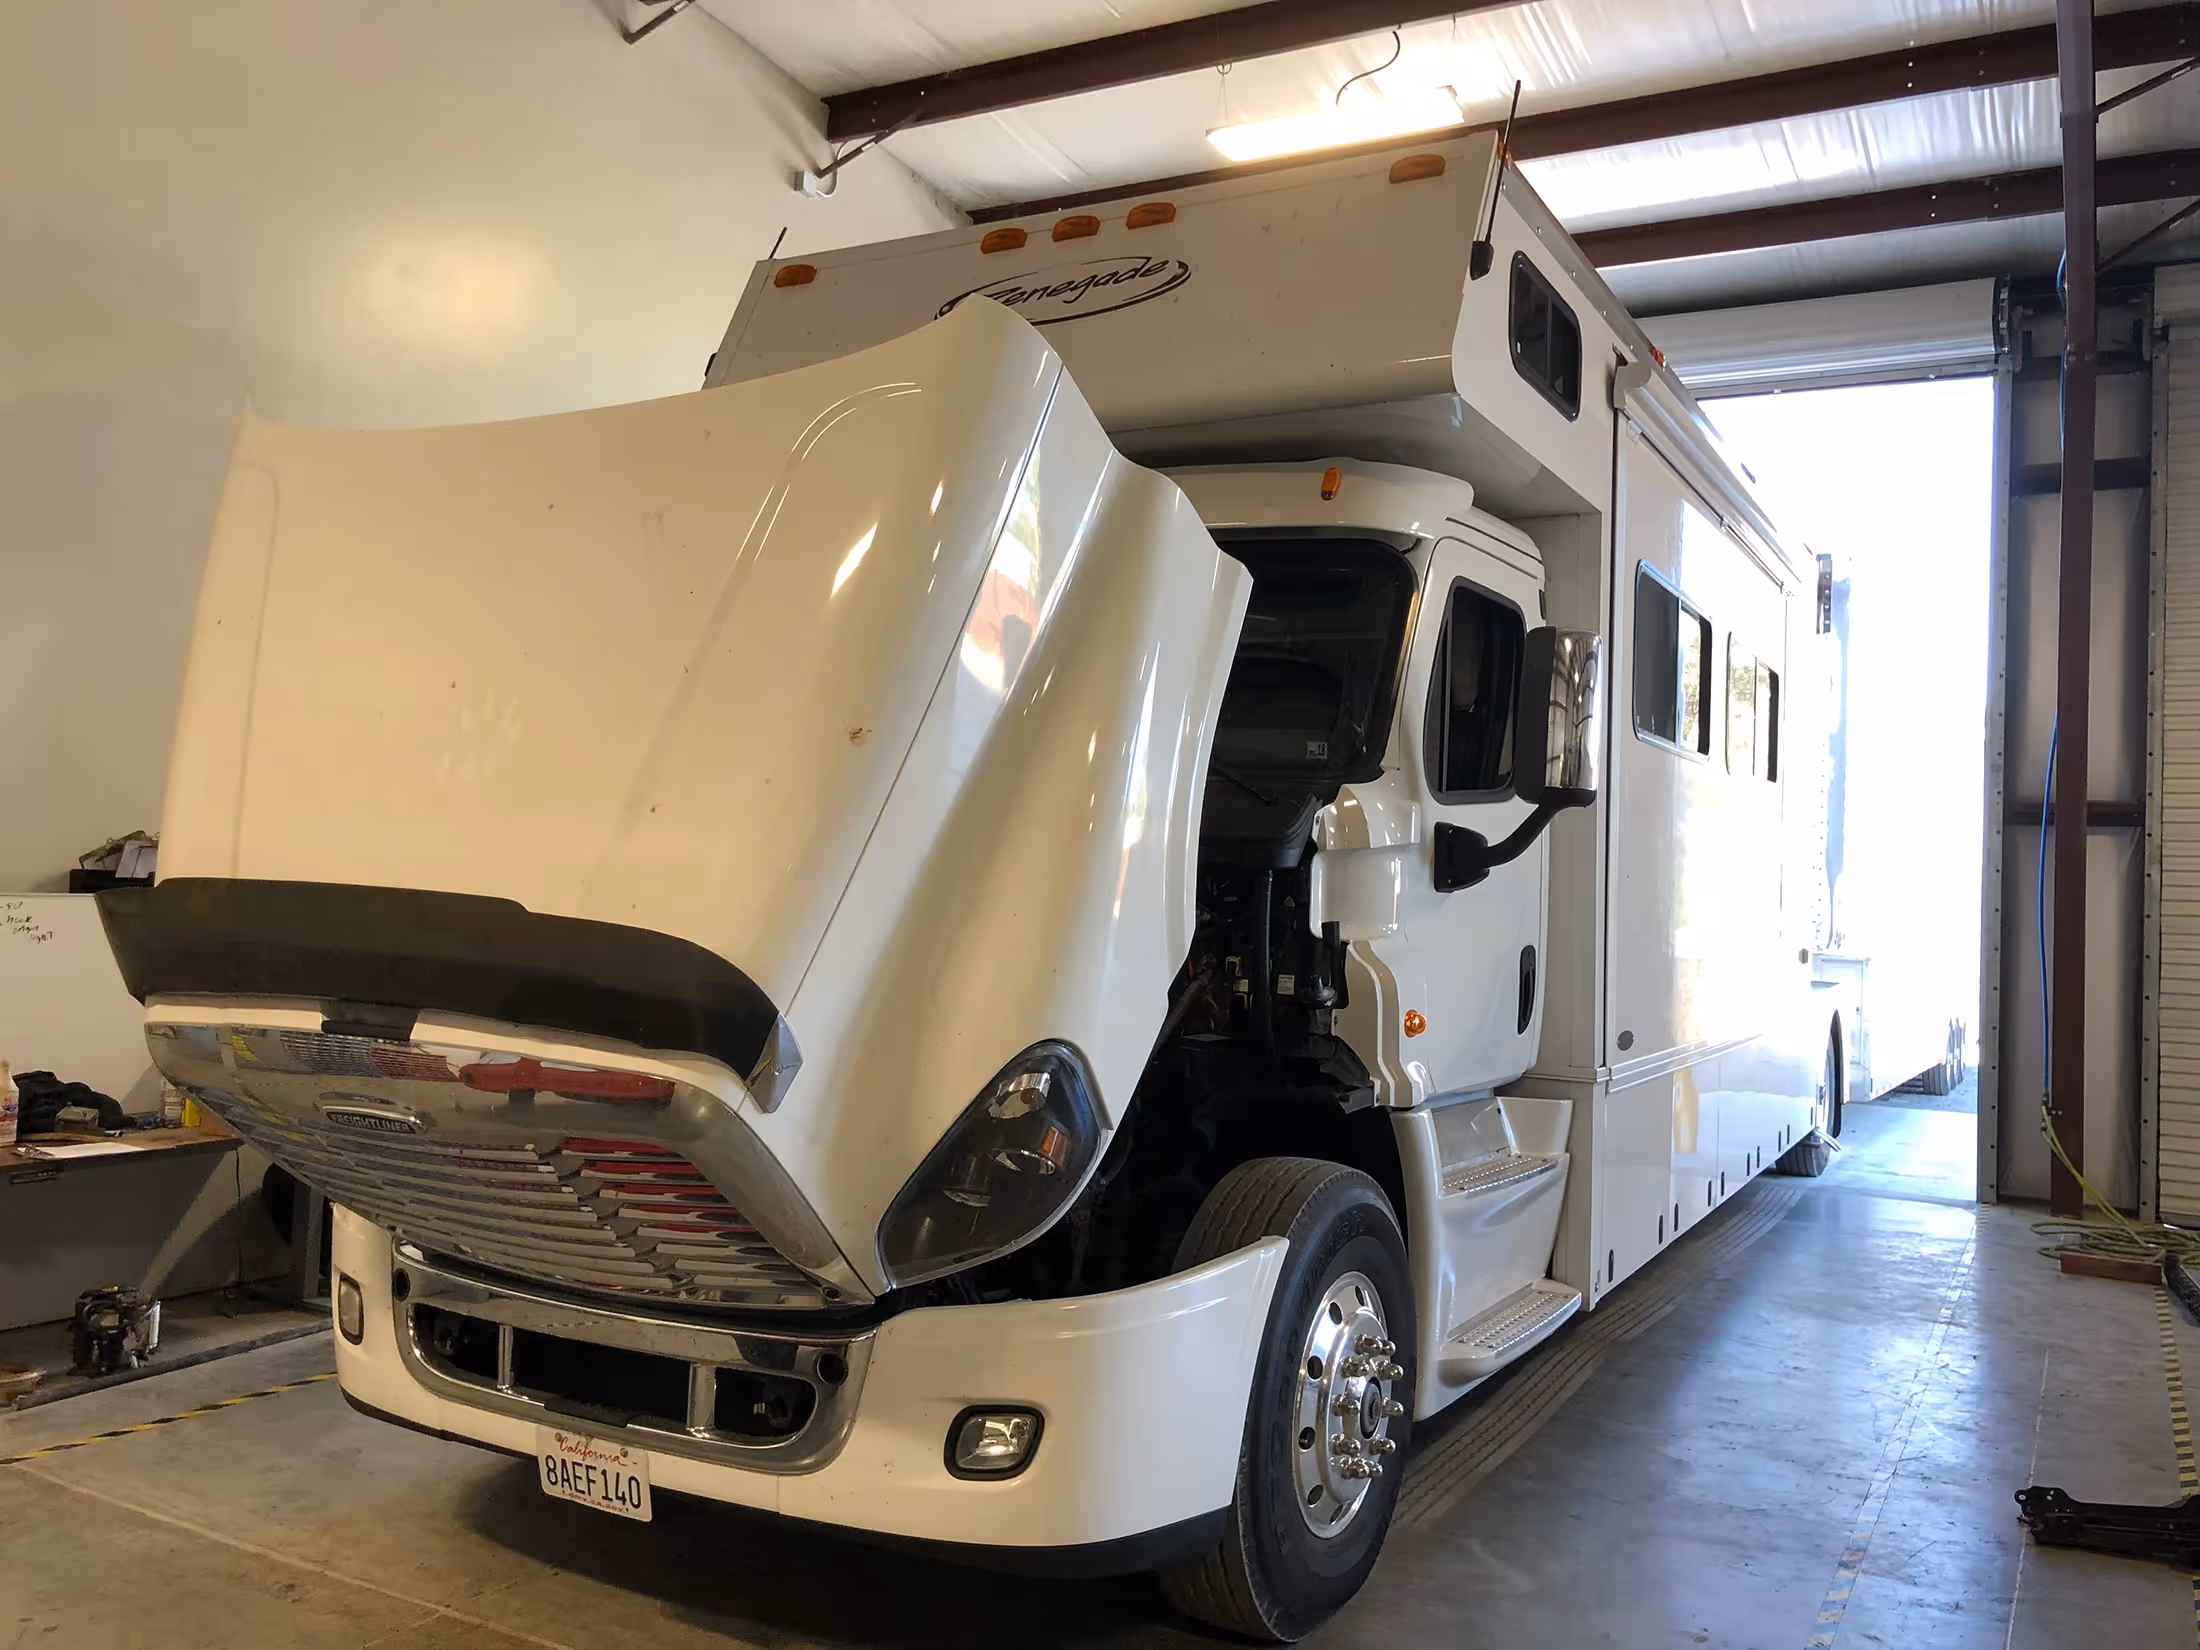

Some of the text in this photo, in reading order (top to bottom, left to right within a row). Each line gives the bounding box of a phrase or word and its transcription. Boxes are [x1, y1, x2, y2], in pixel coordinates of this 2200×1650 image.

[331, 1113, 411, 1133] FREIGHTLINER
[559, 1436, 628, 1467] California
[545, 1454, 642, 1509] 8AEF140
